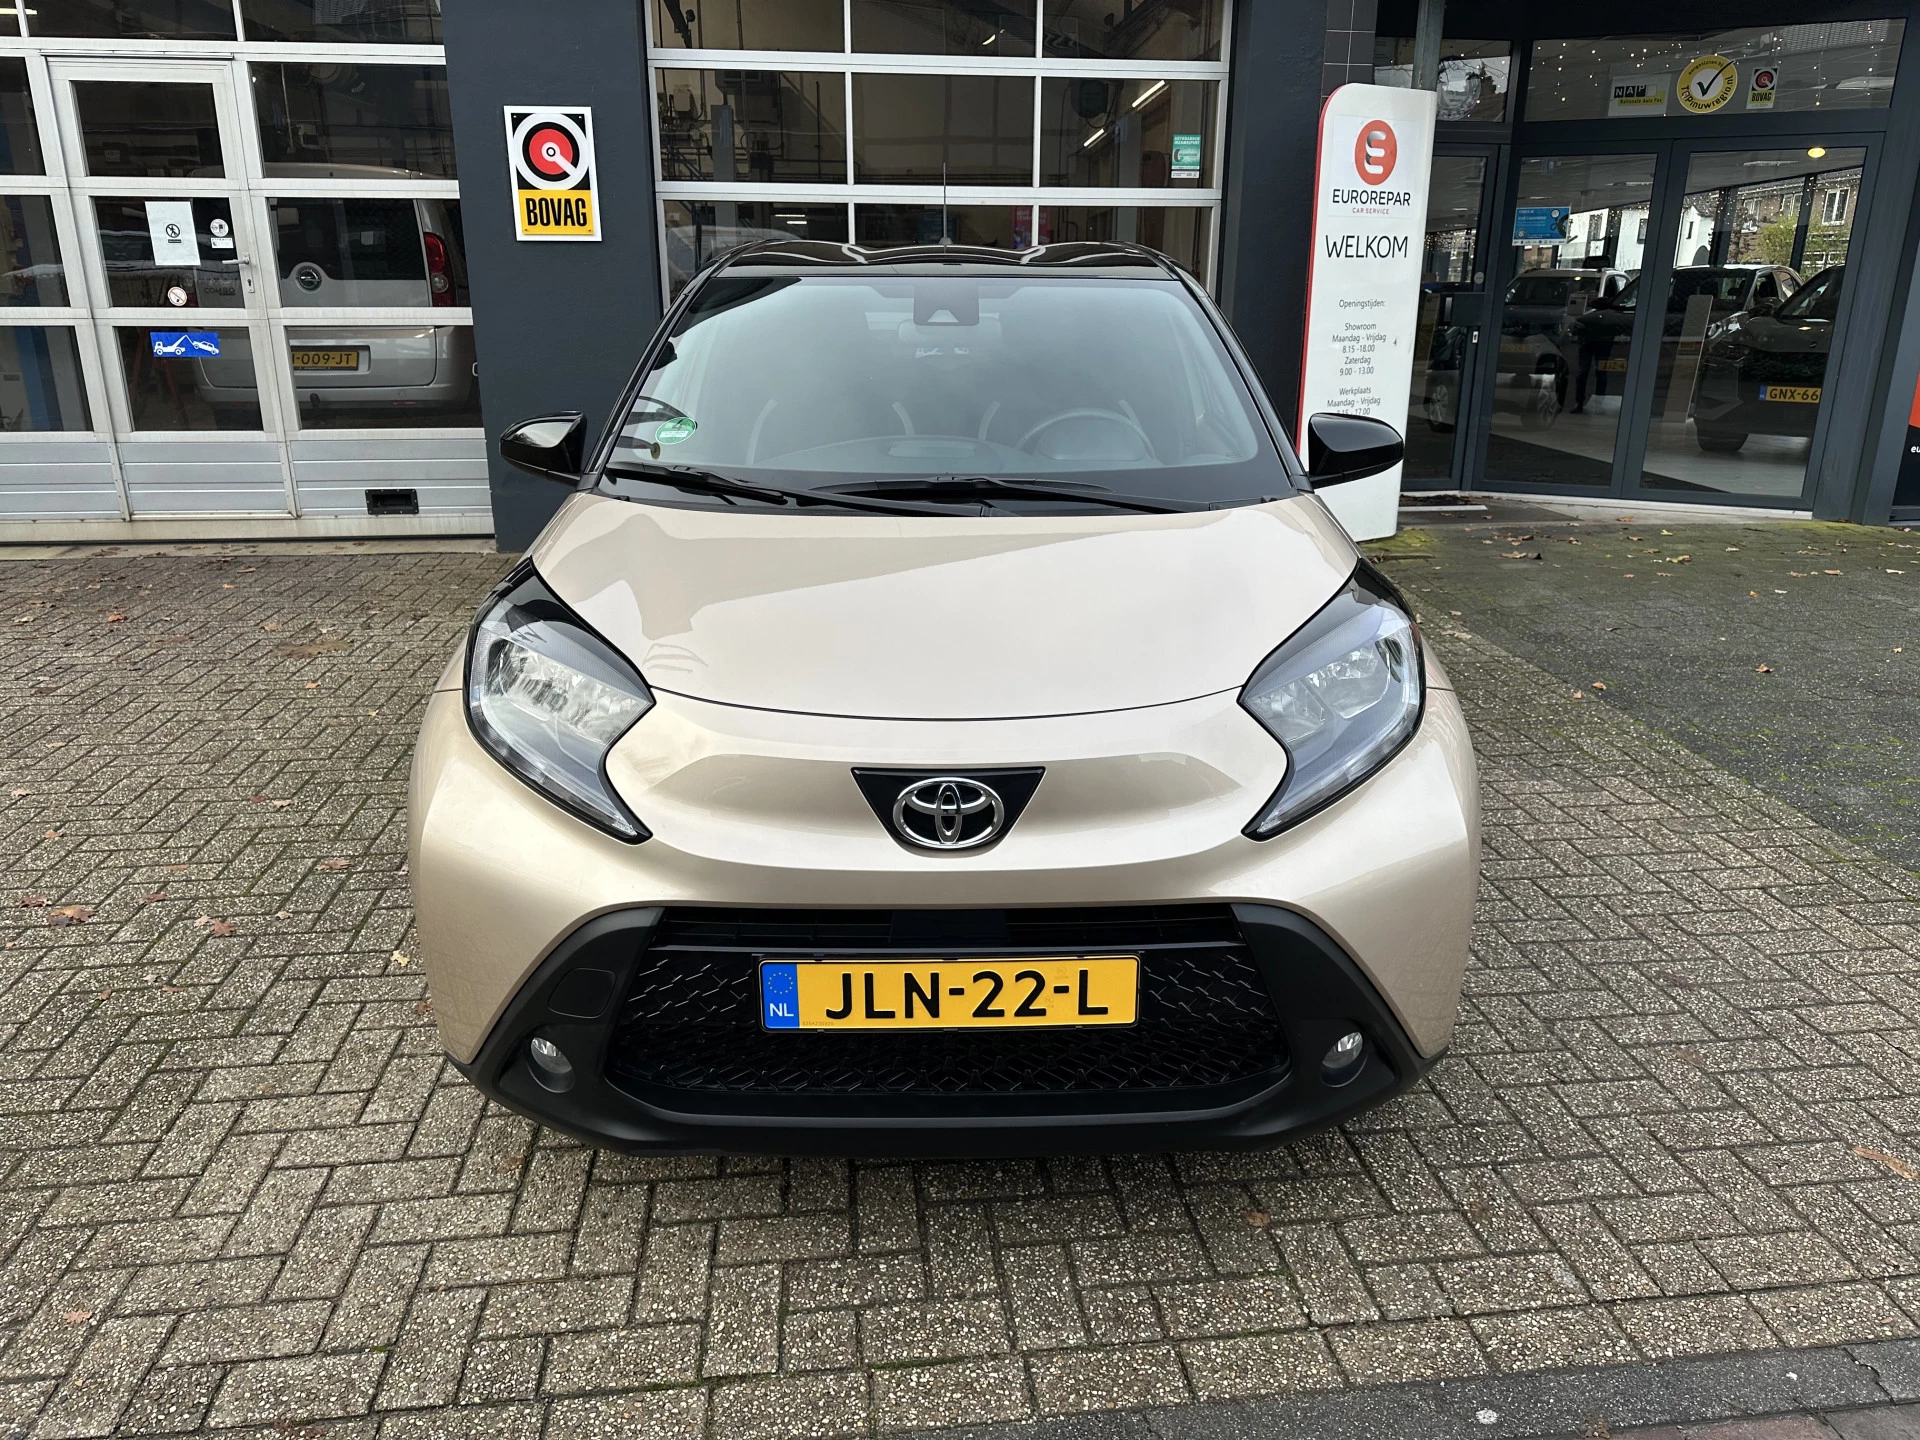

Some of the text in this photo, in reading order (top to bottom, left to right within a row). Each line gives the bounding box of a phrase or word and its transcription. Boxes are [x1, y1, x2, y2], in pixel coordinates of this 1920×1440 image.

[1752, 92, 1772, 102] BOVAG
[1332, 189, 1411, 206] EUROREPAR
[525, 197, 588, 227] BOVAG
[1325, 234, 1408, 258] WELKOM
[1338, 299, 1385, 309] Openingstijden:
[1344, 322, 1376, 331] Showroom
[1332, 334, 1361, 344] Maandag
[1366, 333, 1387, 343] Vrijdag
[1342, 345, 1355, 353] 8.15
[292, 353, 352, 365] -009-JT
[1344, 356, 1371, 365] Zaterdag
[1340, 367, 1353, 376] 9.00
[1358, 366, 1374, 375] 13.00
[1339, 387, 1371, 396] Werkplaats
[1770, 388, 1819, 401] GNX-66
[1327, 399, 1355, 408] Maandag
[1360, 397, 1381, 406] Vrijdag
[826, 968, 1109, 1020] JLN-22-L
[769, 1003, 794, 1017] NL
